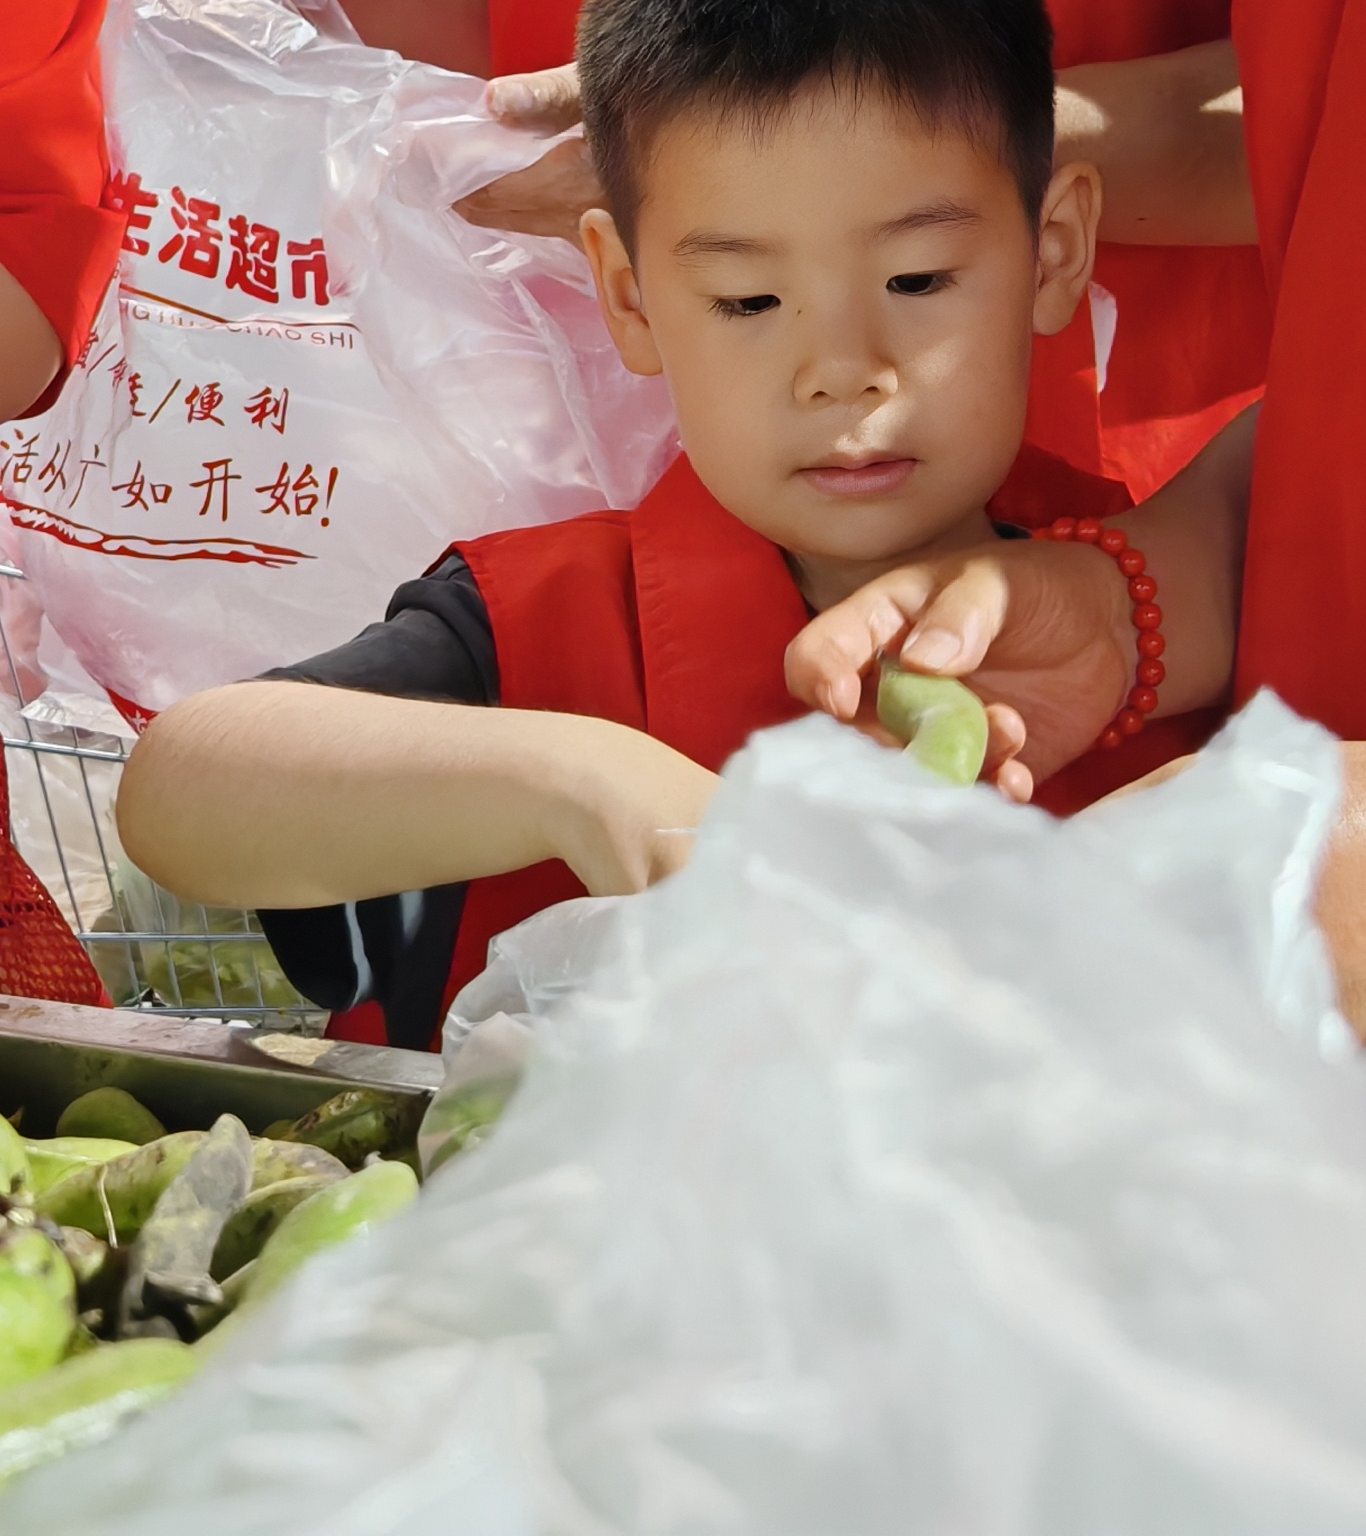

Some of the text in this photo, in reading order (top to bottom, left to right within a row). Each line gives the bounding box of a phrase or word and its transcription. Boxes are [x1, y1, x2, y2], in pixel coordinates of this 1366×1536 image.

[107, 172, 332, 307] 生活超市
[310, 331, 354, 350] SHI
